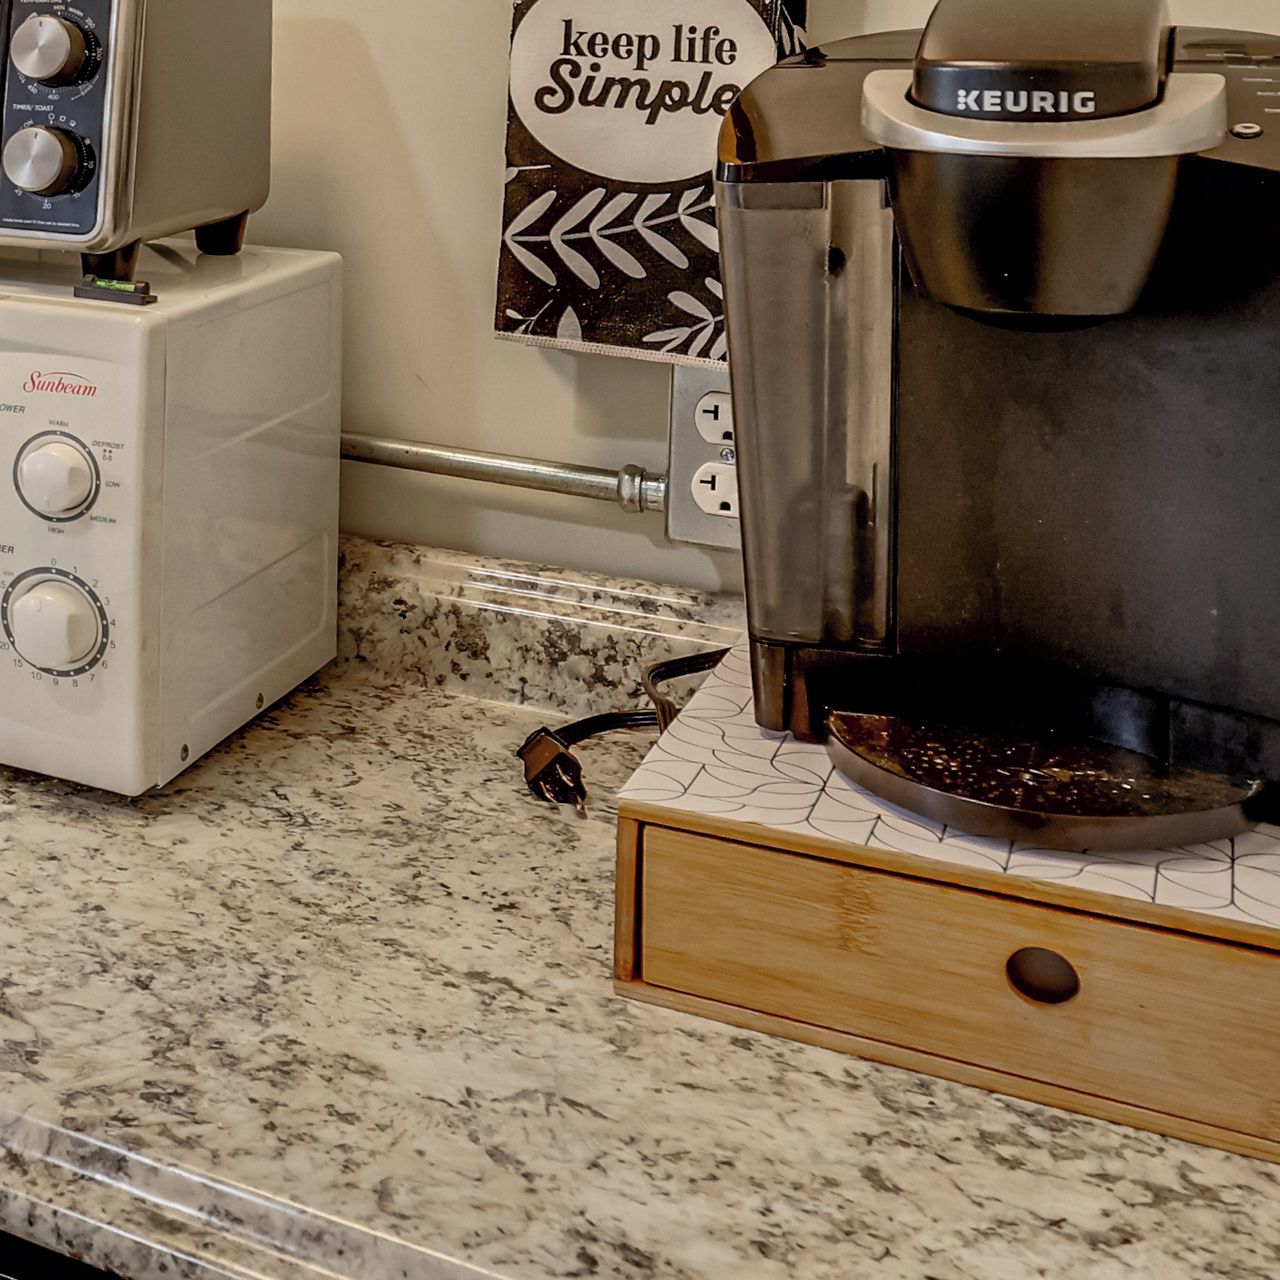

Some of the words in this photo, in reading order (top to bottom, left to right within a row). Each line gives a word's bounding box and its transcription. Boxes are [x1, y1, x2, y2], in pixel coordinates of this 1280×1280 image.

[561, 18, 662, 74] keep
[671, 24, 738, 66] life
[533, 56, 742, 125] Simple
[957, 88, 1097, 114] KEURIG
[22, 370, 97, 398] Sunbeam
[91, 440, 125, 450] DEFROST
[105, 480, 121, 488] LOW
[89, 515, 117, 524] MEDIUM
[47, 526, 65, 534] HIGH
[50, 558, 57, 566] 0
[92, 579, 99, 588] 2
[104, 597, 110, 605] 3
[110, 619, 116, 627] 4
[0, 641, 10, 650] 20
[110, 641, 116, 649] 5
[13, 658, 23, 668] 15
[102, 660, 108, 669] 6
[31, 671, 42, 681] 10
[90, 674, 96, 682] 7
[53, 678, 59, 686] 9
[72, 679, 79, 688] 8
